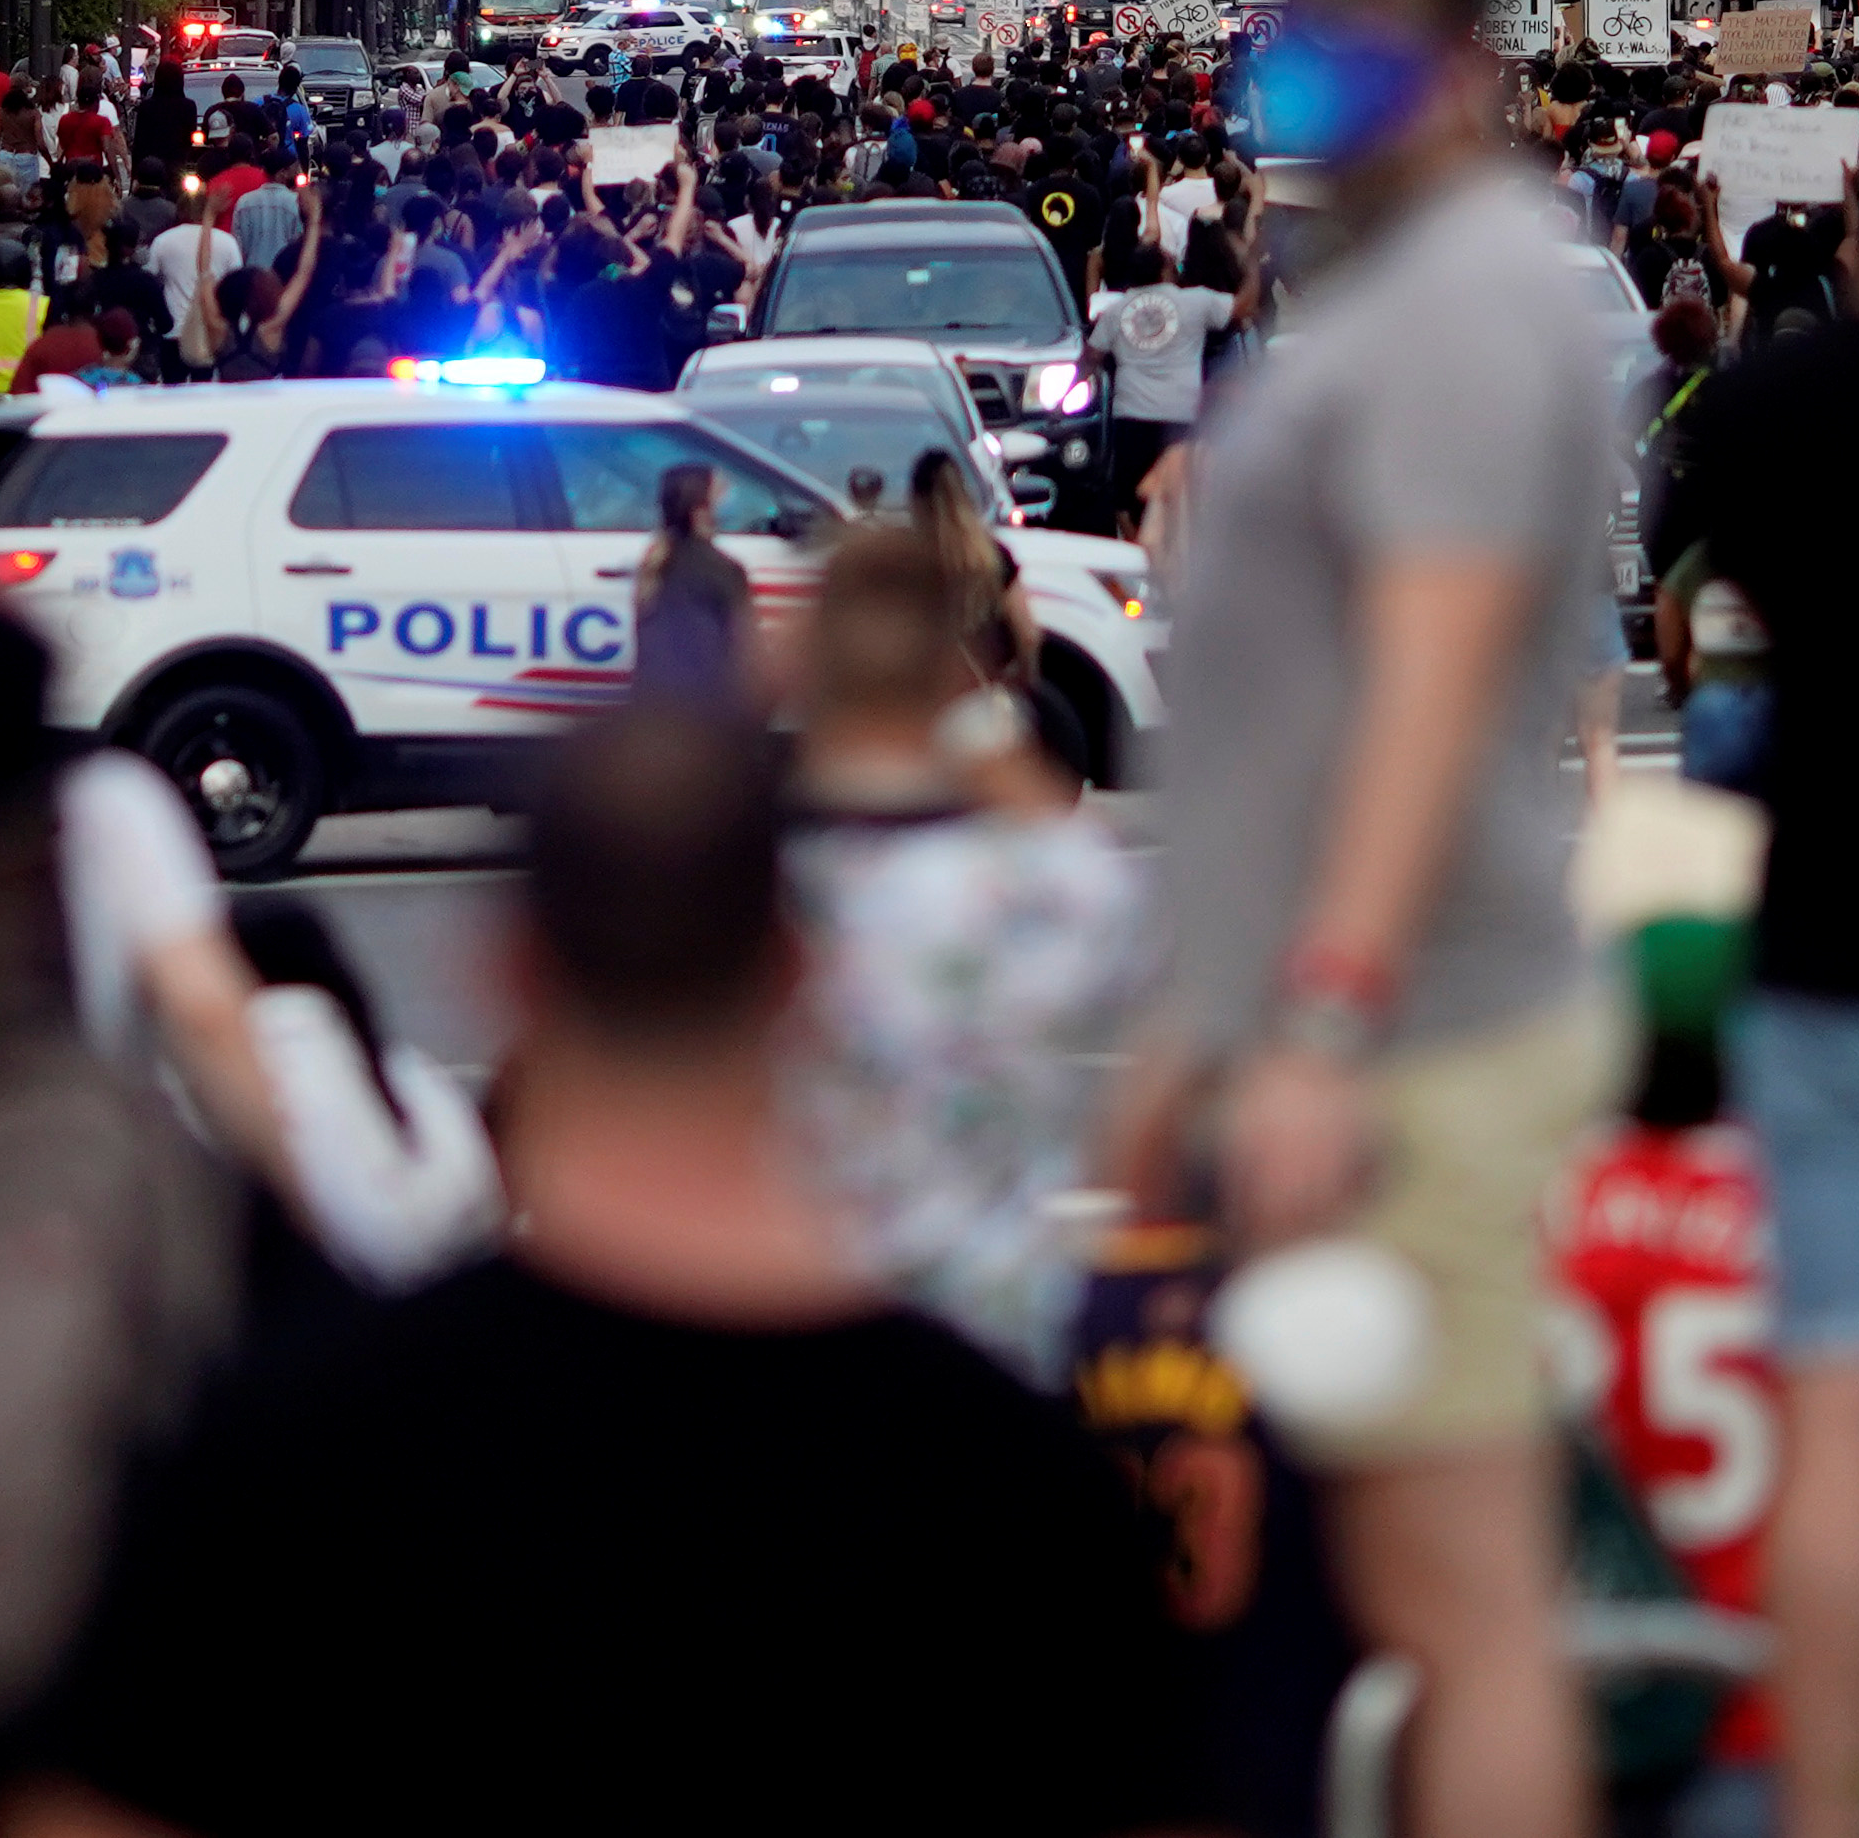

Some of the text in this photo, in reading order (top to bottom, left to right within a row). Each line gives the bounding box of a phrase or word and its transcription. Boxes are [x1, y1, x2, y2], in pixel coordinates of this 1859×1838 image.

[1484, 20, 1549, 34] OBEY THIS
[1727, 17, 1749, 28] THE
[1753, 29, 1774, 40] WILL
[1777, 28, 1807, 39] NEVER
[639, 35, 685, 47] POLICE
[1485, 38, 1527, 51] SIGNAL
[1720, 38, 1806, 51] DISMANTLE THE
[1598, 42, 1612, 54] SE
[326, 599, 623, 664] POLIC
